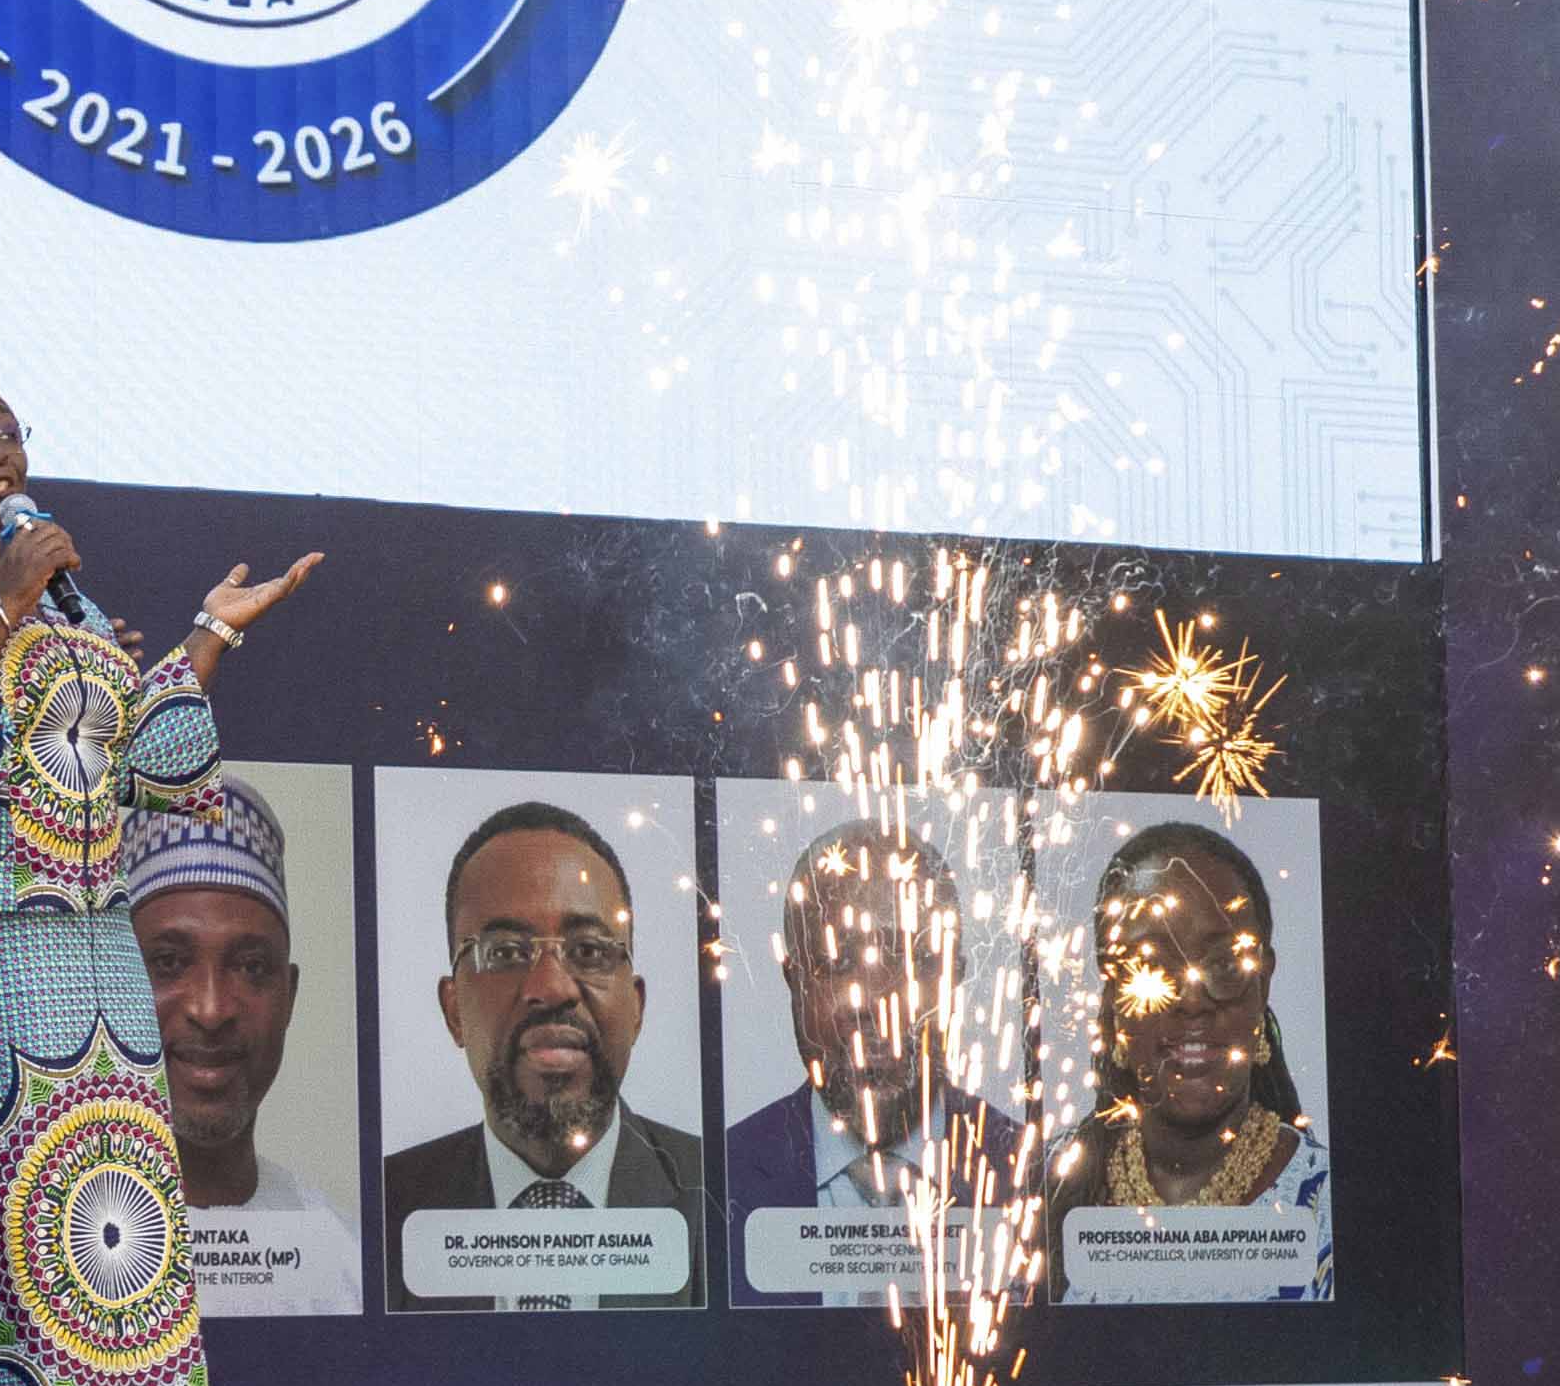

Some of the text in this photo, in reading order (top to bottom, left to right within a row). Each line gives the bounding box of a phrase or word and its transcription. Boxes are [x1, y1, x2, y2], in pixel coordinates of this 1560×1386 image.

[22, 68, 188, 176] 2021
[252, 100, 413, 184] 2026
[188, 1229, 250, 1244] UNTAKA
[800, 1224, 822, 1239] DR.
[825, 1224, 869, 1239] DIVINE
[871, 1224, 911, 1238] SELAS
[1079, 1229, 1306, 1245] PROFESSOR NANA ABA APPIAH AMFO
[444, 1233, 653, 1249] DR. JOHNSON PANDIT ASIAMA
[265, 1247, 301, 1269] (MP)
[830, 1243, 922, 1258] DIRECTOR-GEN
[1188, 1248, 1243, 1261] UNIVERSITY
[1246, 1248, 1259, 1260] OF
[1261, 1248, 1298, 1260] GHANA
[448, 1253, 650, 1269] GOVERNOR OF THE BANK OF GHANA
[809, 1261, 958, 1275] CYBER SECURITY AUTITY
[197, 1272, 274, 1285] THE INTERIOR
